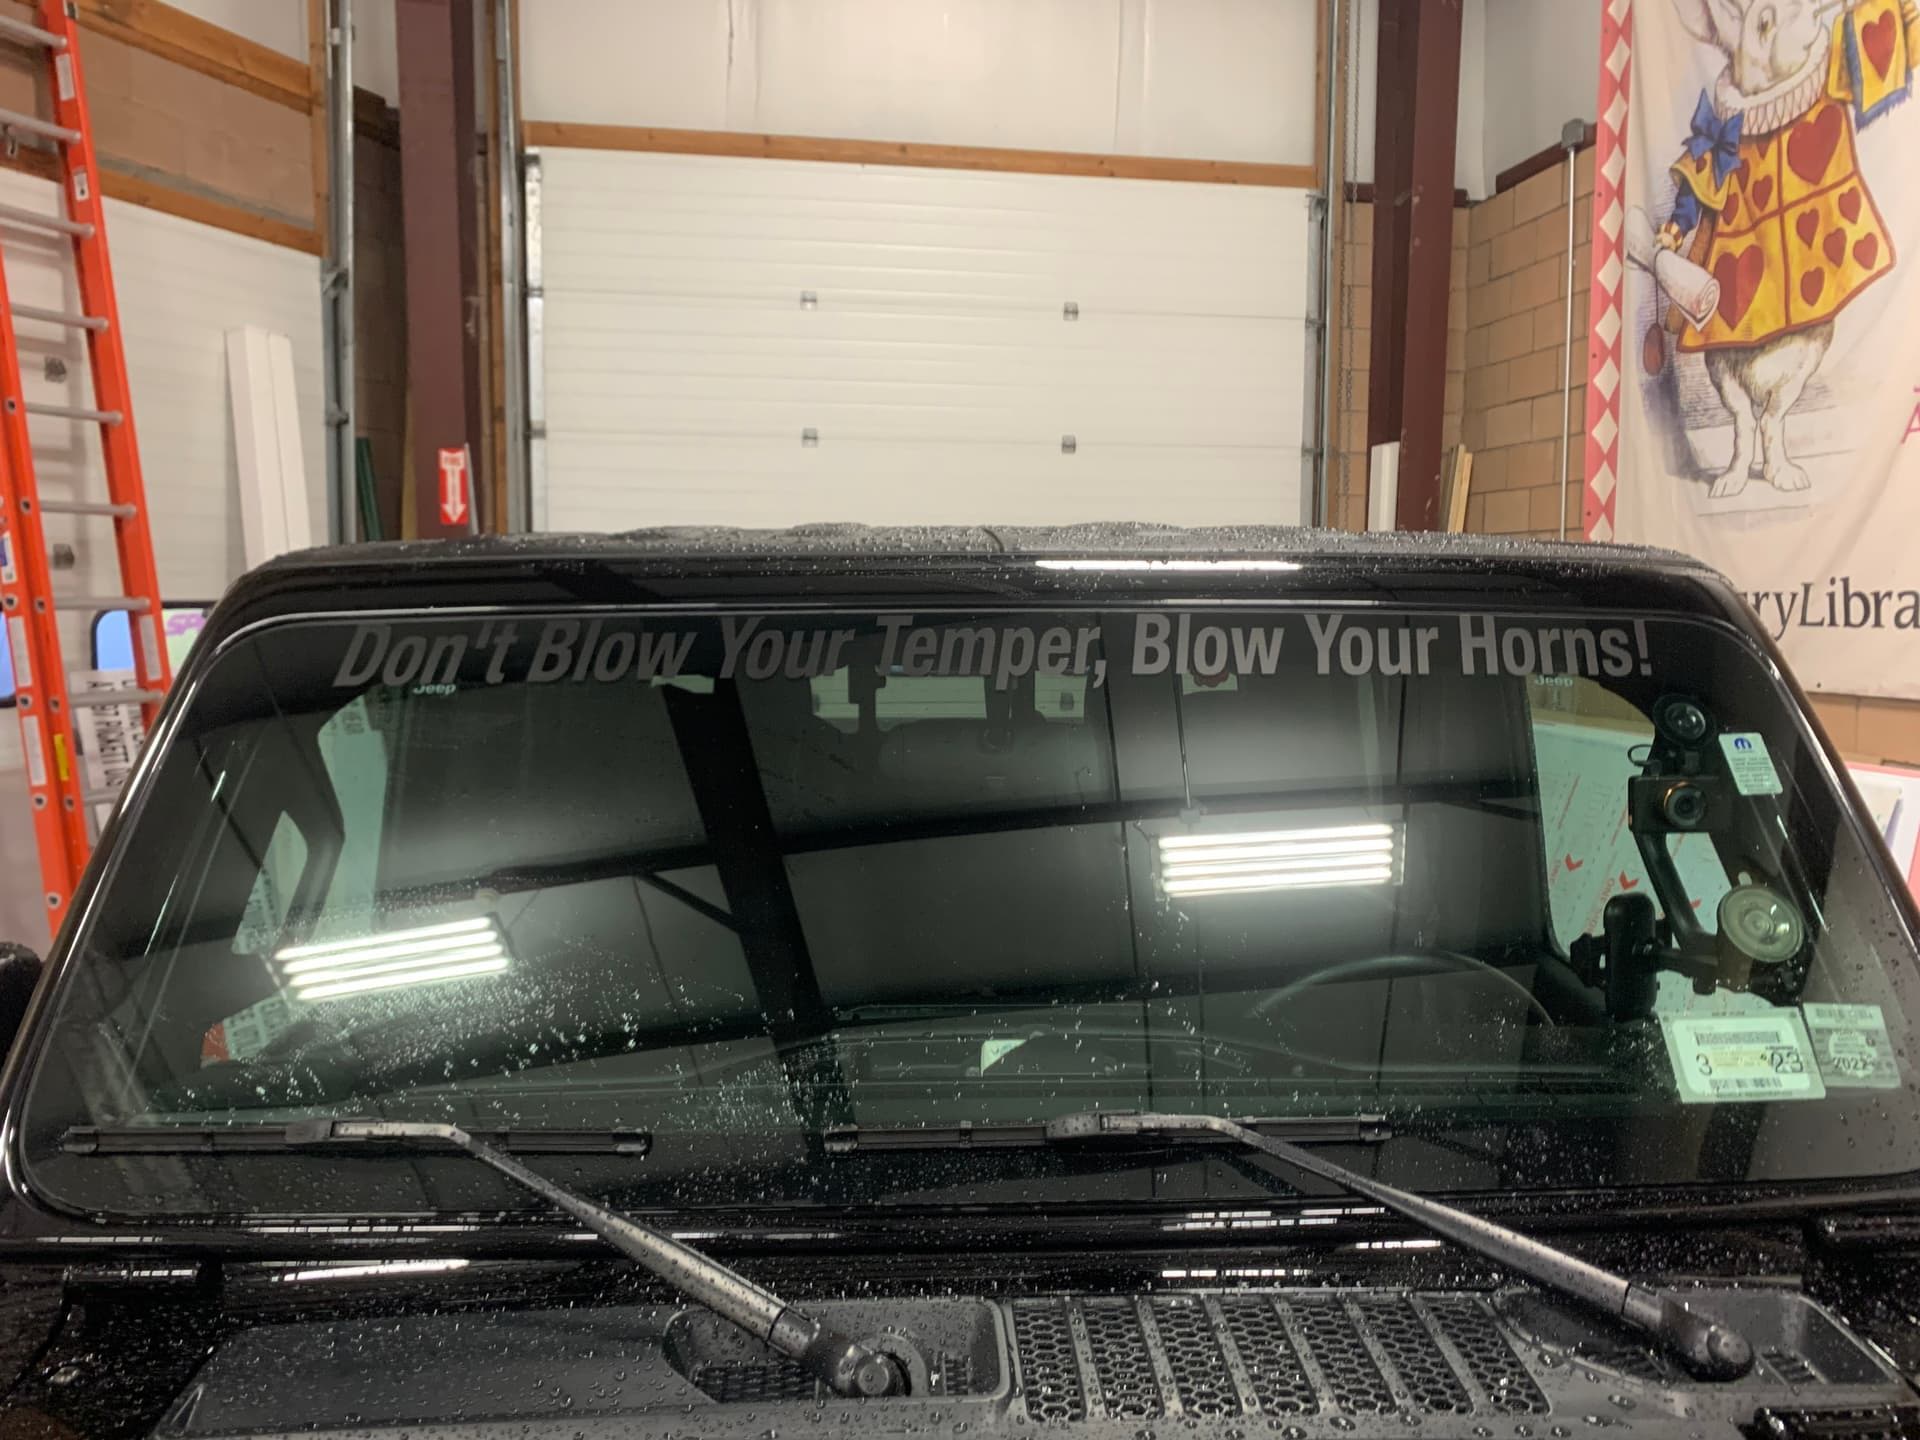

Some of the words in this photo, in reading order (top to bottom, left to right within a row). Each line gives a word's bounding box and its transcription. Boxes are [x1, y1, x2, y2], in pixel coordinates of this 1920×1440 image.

[1737, 576, 1920, 642] ryLibra
[332, 620, 519, 687] Don't
[526, 618, 698, 683] Blow
[719, 616, 856, 680] Your
[876, 614, 1108, 691] Temper,
[1131, 613, 1285, 675] Blow
[1303, 614, 1439, 676] Your
[1459, 614, 1653, 677] Horns!
[1695, 1053, 1712, 1076] 3
